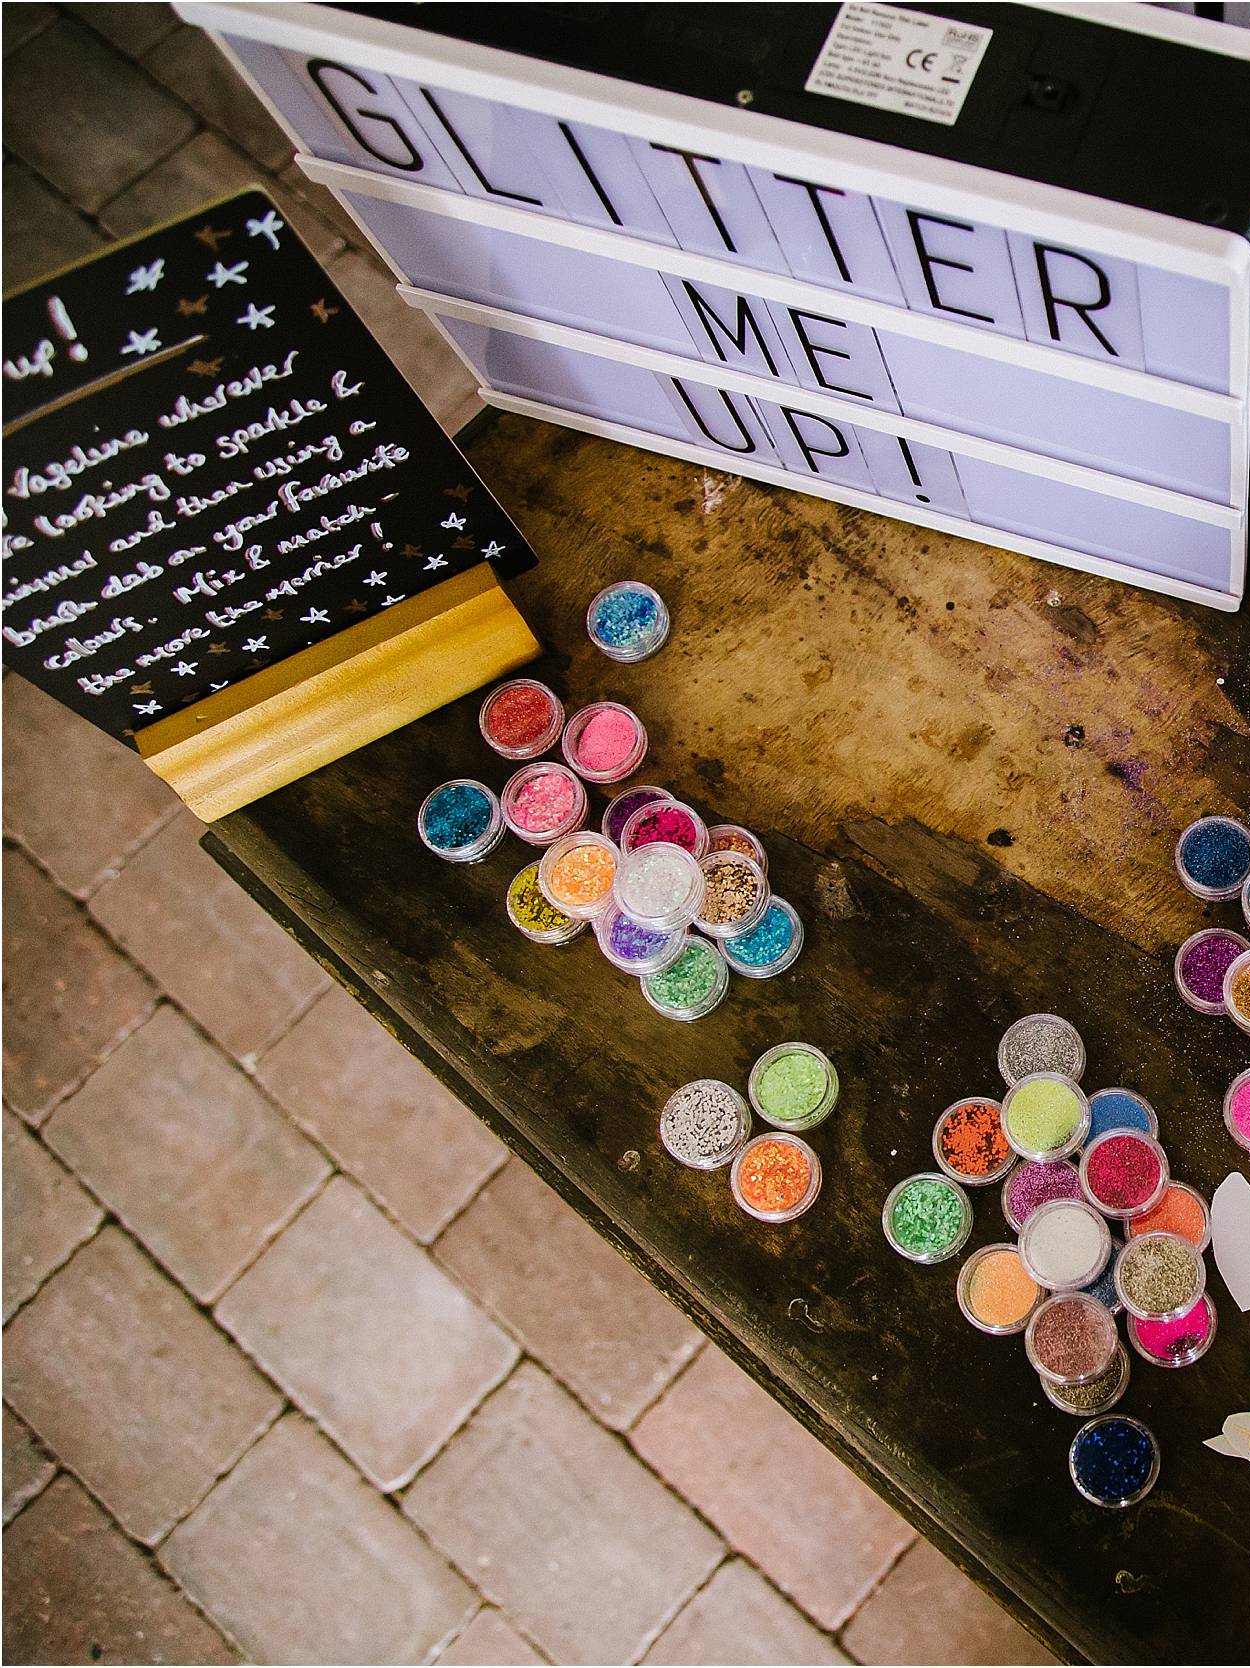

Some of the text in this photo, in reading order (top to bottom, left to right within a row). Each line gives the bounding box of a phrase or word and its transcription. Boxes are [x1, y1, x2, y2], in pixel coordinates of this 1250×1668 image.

[306, 58, 1119, 357] GLITTER
[157, 350, 299, 428] wherever
[683, 279, 874, 402] ME
[34, 473, 171, 537] looking
[163, 453, 207, 476] to
[215, 398, 328, 459] sparkle
[331, 369, 365, 399] &
[109, 510, 177, 553] and
[176, 480, 254, 517] then
[253, 434, 344, 480] using
[349, 420, 377, 436] a
[671, 377, 931, 504] UP!
[2, 443, 410, 648] brush dab on your favourite
[173, 569, 246, 606] Mix
[244, 544, 271, 571] &
[277, 504, 377, 555] match
[77, 667, 136, 696] the
[135, 627, 211, 668] more
[204, 599, 264, 627] the
